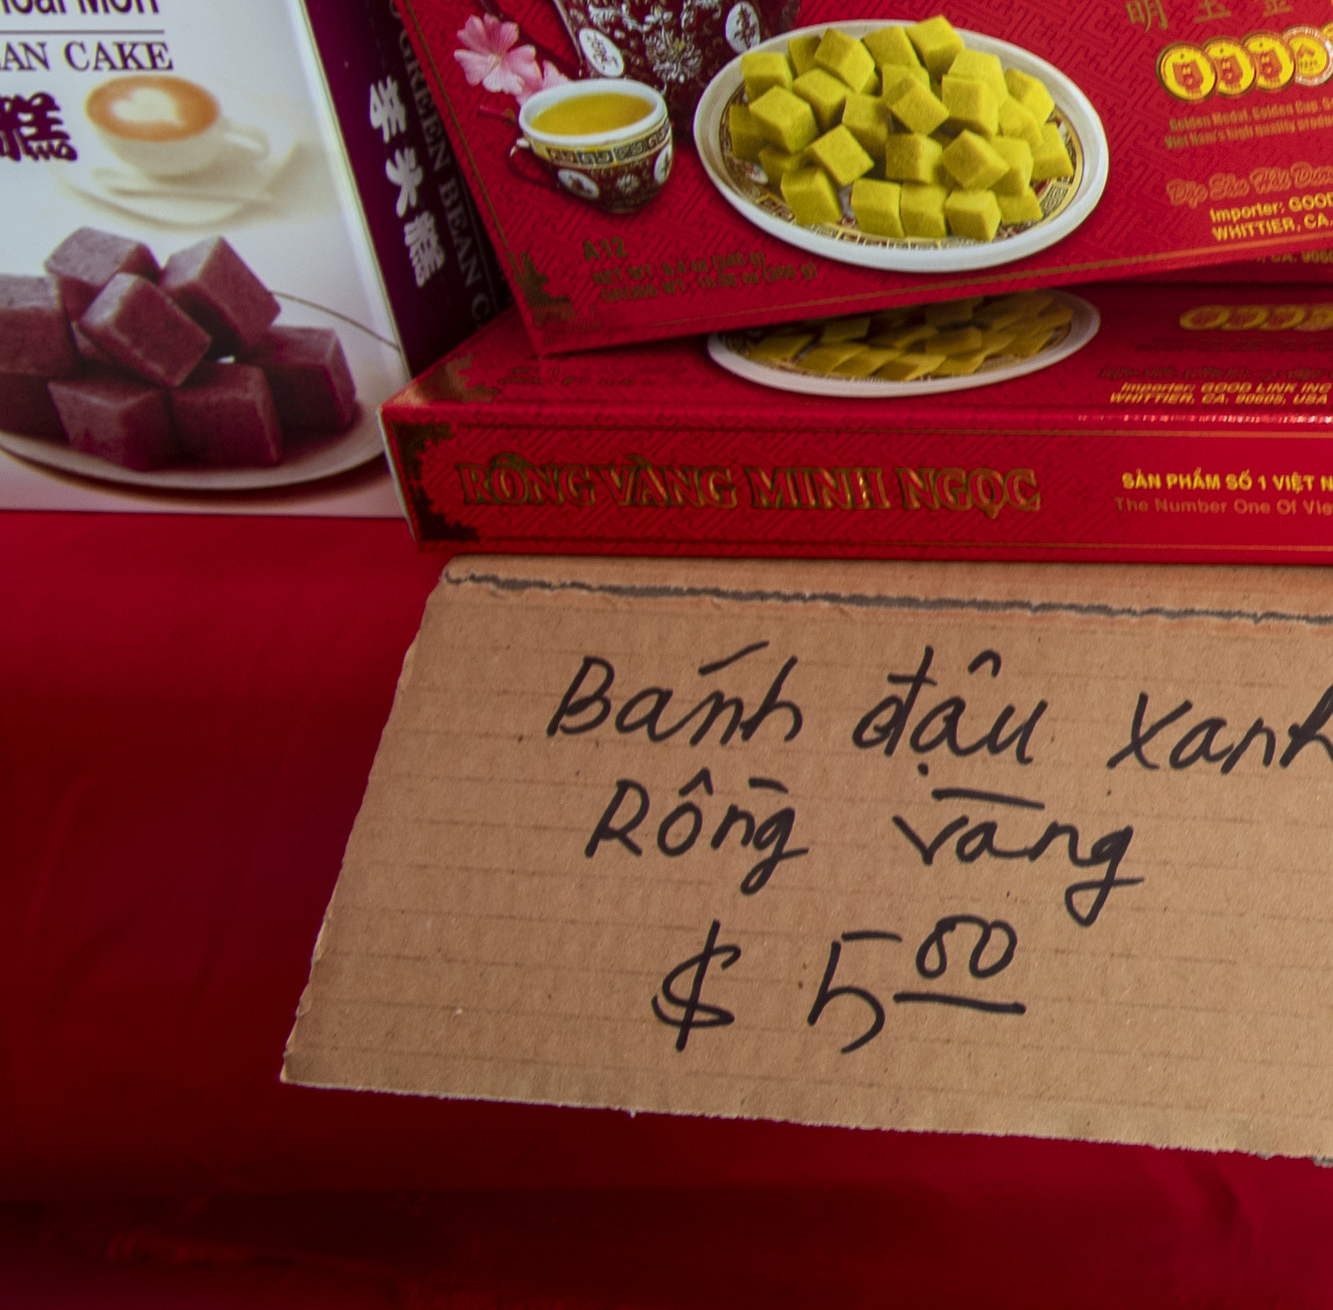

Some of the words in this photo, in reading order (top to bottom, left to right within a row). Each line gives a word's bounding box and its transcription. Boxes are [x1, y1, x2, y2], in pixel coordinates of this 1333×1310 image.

[0, 42, 50, 71] AN
[63, 41, 174, 71] CAKE
[1209, 202, 1285, 224] Importer:
[438, 180, 481, 288] BEAN
[1211, 219, 1301, 242] WHITTIER,
[1200, 382, 1252, 394] GOOD
[1255, 382, 1299, 394] LINK
[455, 452, 596, 506] RỒNG
[595, 454, 737, 508] VÀNG
[744, 466, 890, 510] MINH
[895, 466, 1041, 520] NGỌC
[1257, 476, 1266, 490] 1
[1272, 472, 1314, 493] VIỆT
[1114, 497, 1149, 512] The
[1155, 498, 1227, 513] Number
[1233, 499, 1271, 514] One
[1277, 499, 1297, 515] Of
[651, 920, 743, 1051] $
